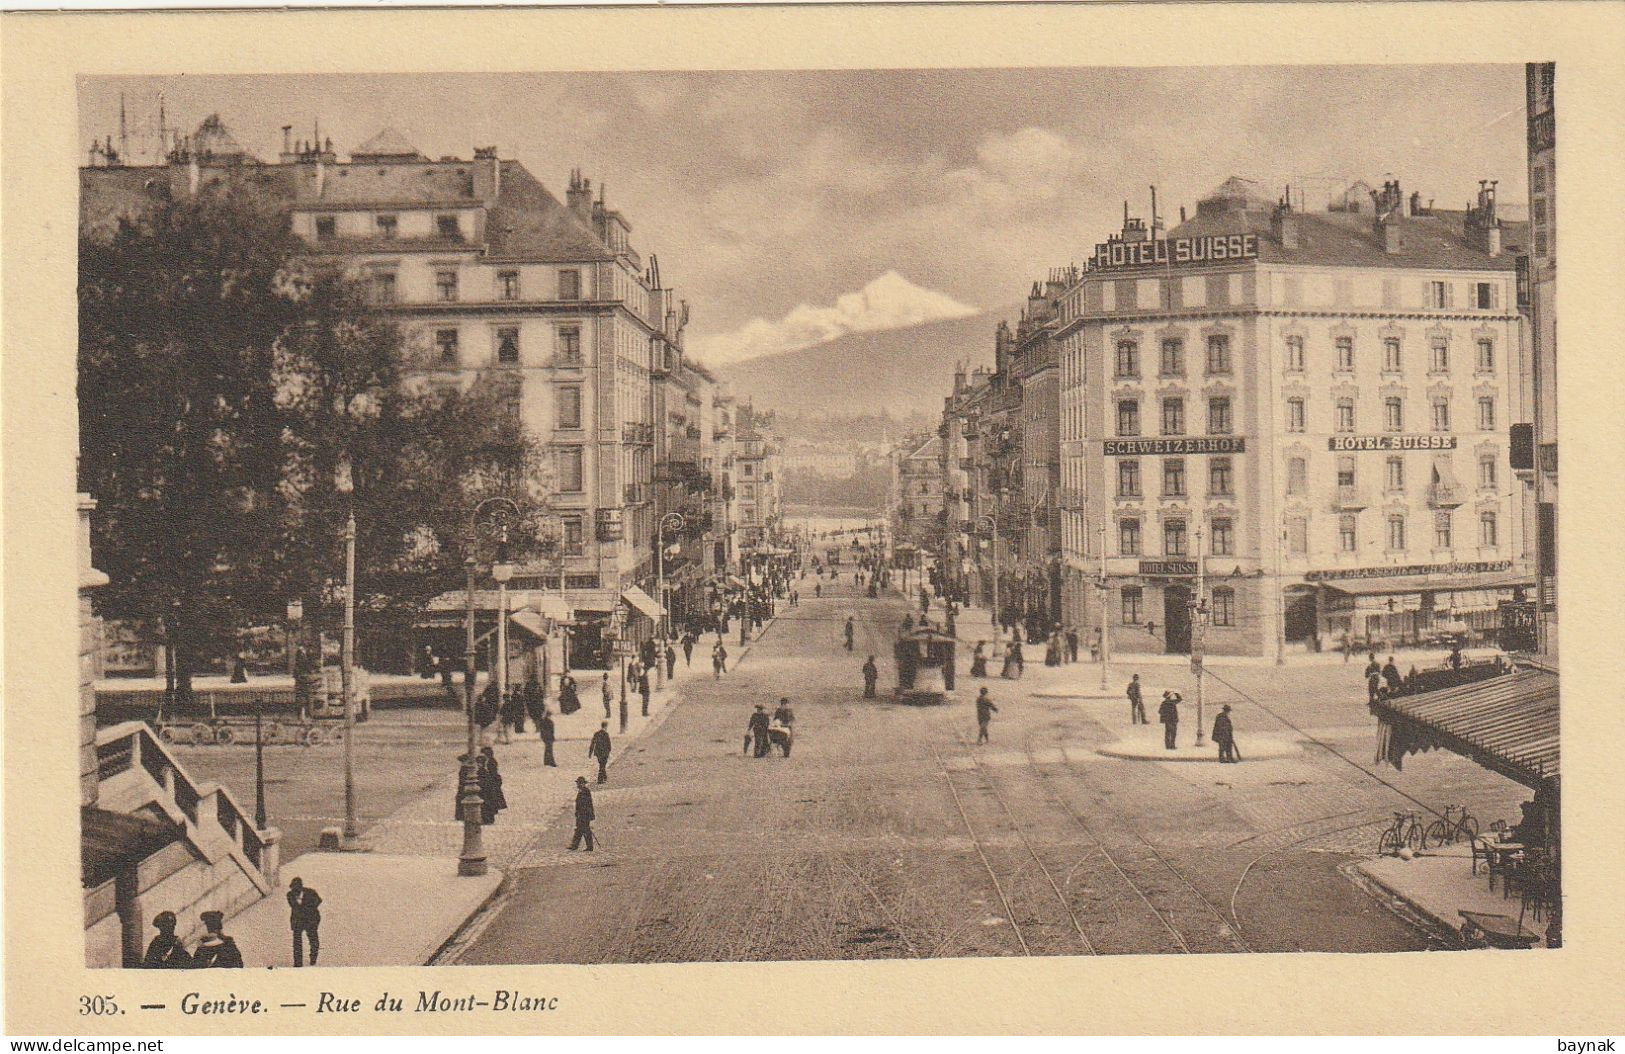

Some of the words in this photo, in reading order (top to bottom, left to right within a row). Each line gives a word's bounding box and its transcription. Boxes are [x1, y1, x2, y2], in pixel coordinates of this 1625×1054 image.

[1097, 242, 1166, 266] HOTEL
[1176, 234, 1256, 260] SUISSE
[1106, 438, 1243, 453] SCHWEIZERHOF
[1391, 436, 1452, 449] SUISSE
